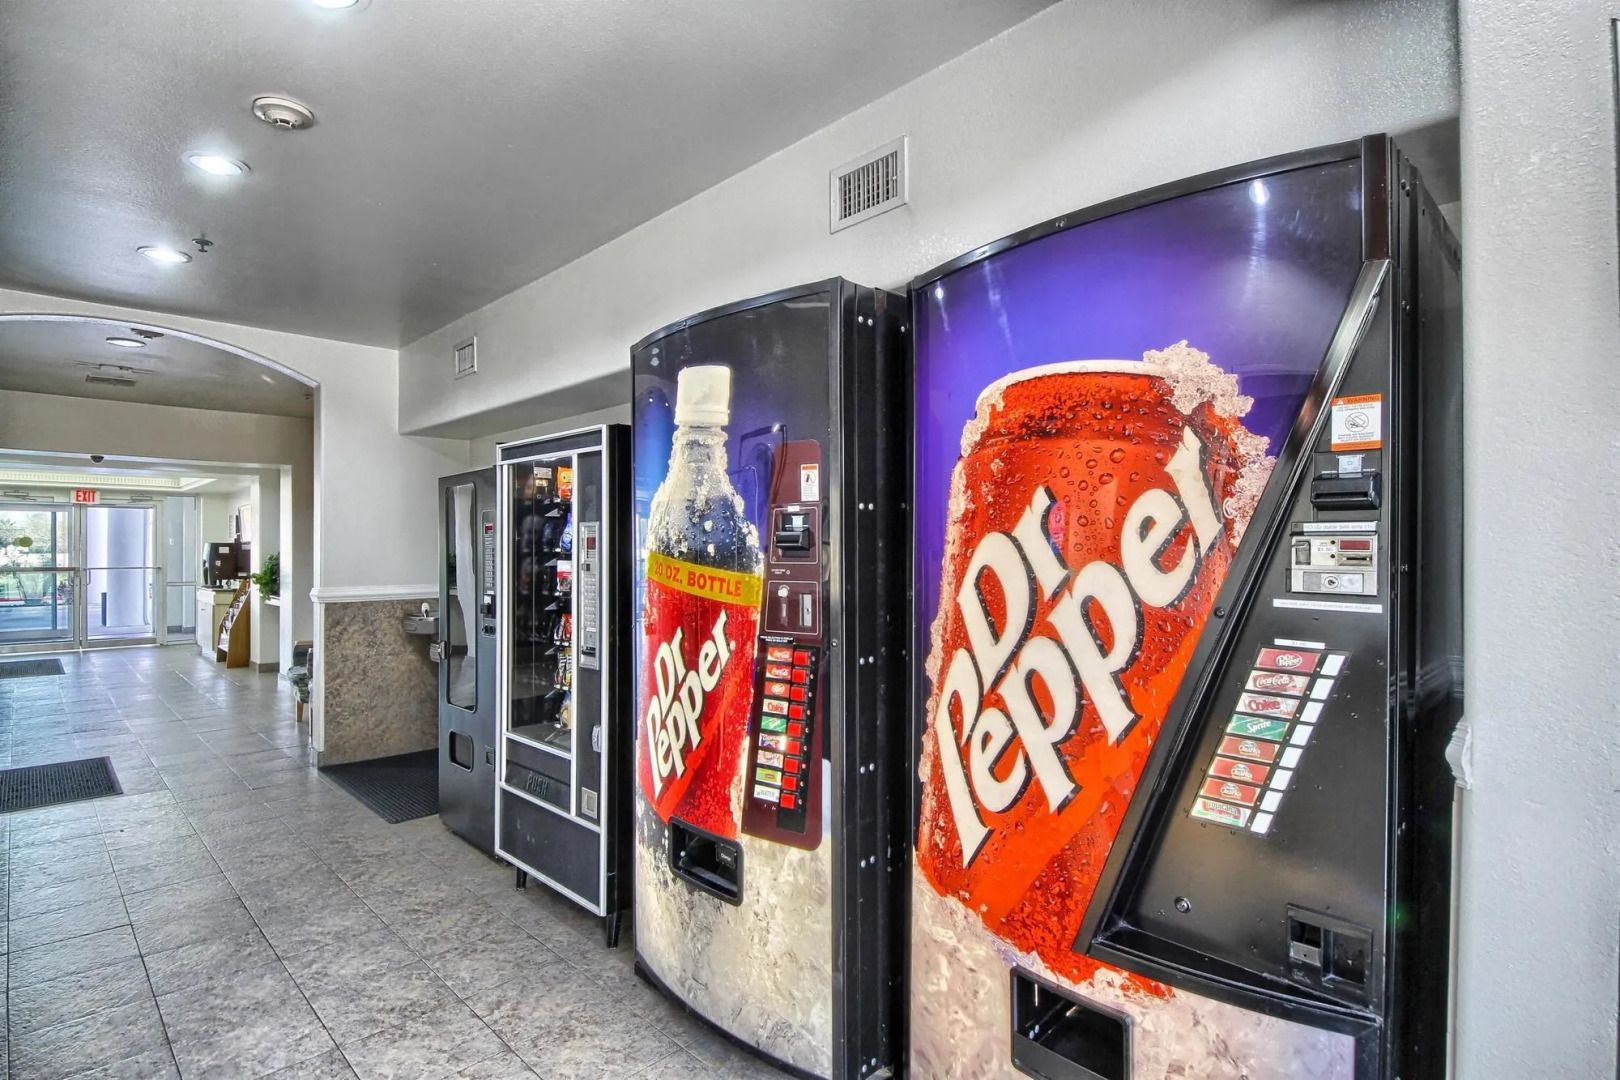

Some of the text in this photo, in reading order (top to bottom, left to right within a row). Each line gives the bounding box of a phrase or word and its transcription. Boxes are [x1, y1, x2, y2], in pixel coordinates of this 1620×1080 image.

[1347, 395, 1379, 404] WARNING
[76, 490, 96, 503] EXIT
[654, 561, 742, 597] 20 OZ. BOTTLE
[934, 425, 1225, 869] Dr Pepper
[654, 626, 687, 719] Dr
[1247, 699, 1281, 712] Coke
[1246, 720, 1271, 733] Sprite
[526, 773, 549, 797] PUSH
